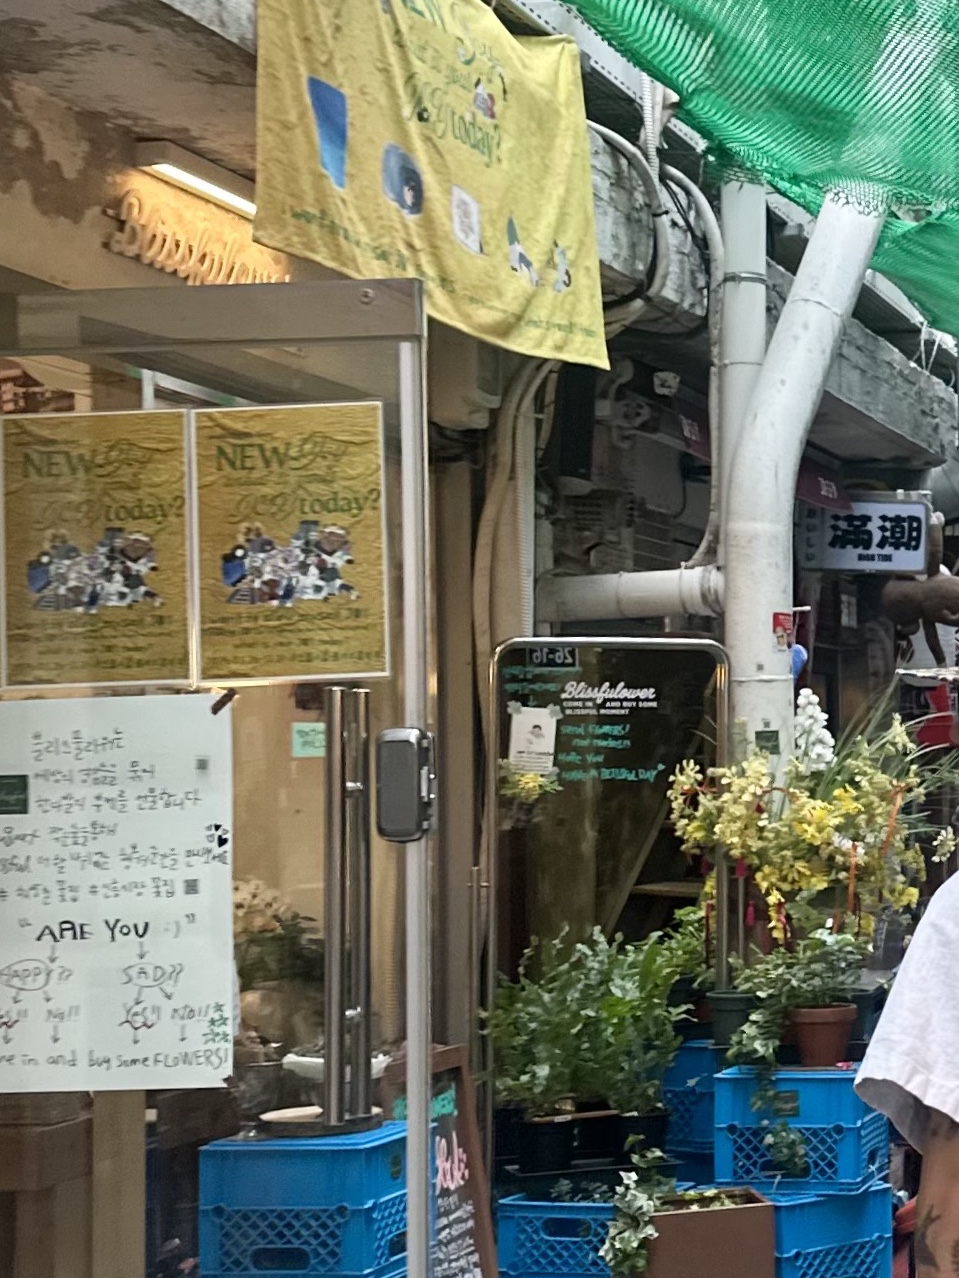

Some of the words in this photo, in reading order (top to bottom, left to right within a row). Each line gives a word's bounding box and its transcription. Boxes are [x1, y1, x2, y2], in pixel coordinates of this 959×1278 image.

[22, 450, 94, 478] NEW
[215, 443, 291, 471] NEW
[104, 495, 185, 524] today?
[298, 488, 381, 517] today?
[560, 681, 656, 704] Blissfulower
[104, 918, 150, 942] YOU
[20, 1053, 39, 1067] in
[46, 1050, 78, 1067] and
[88, 1050, 111, 1071] buy
